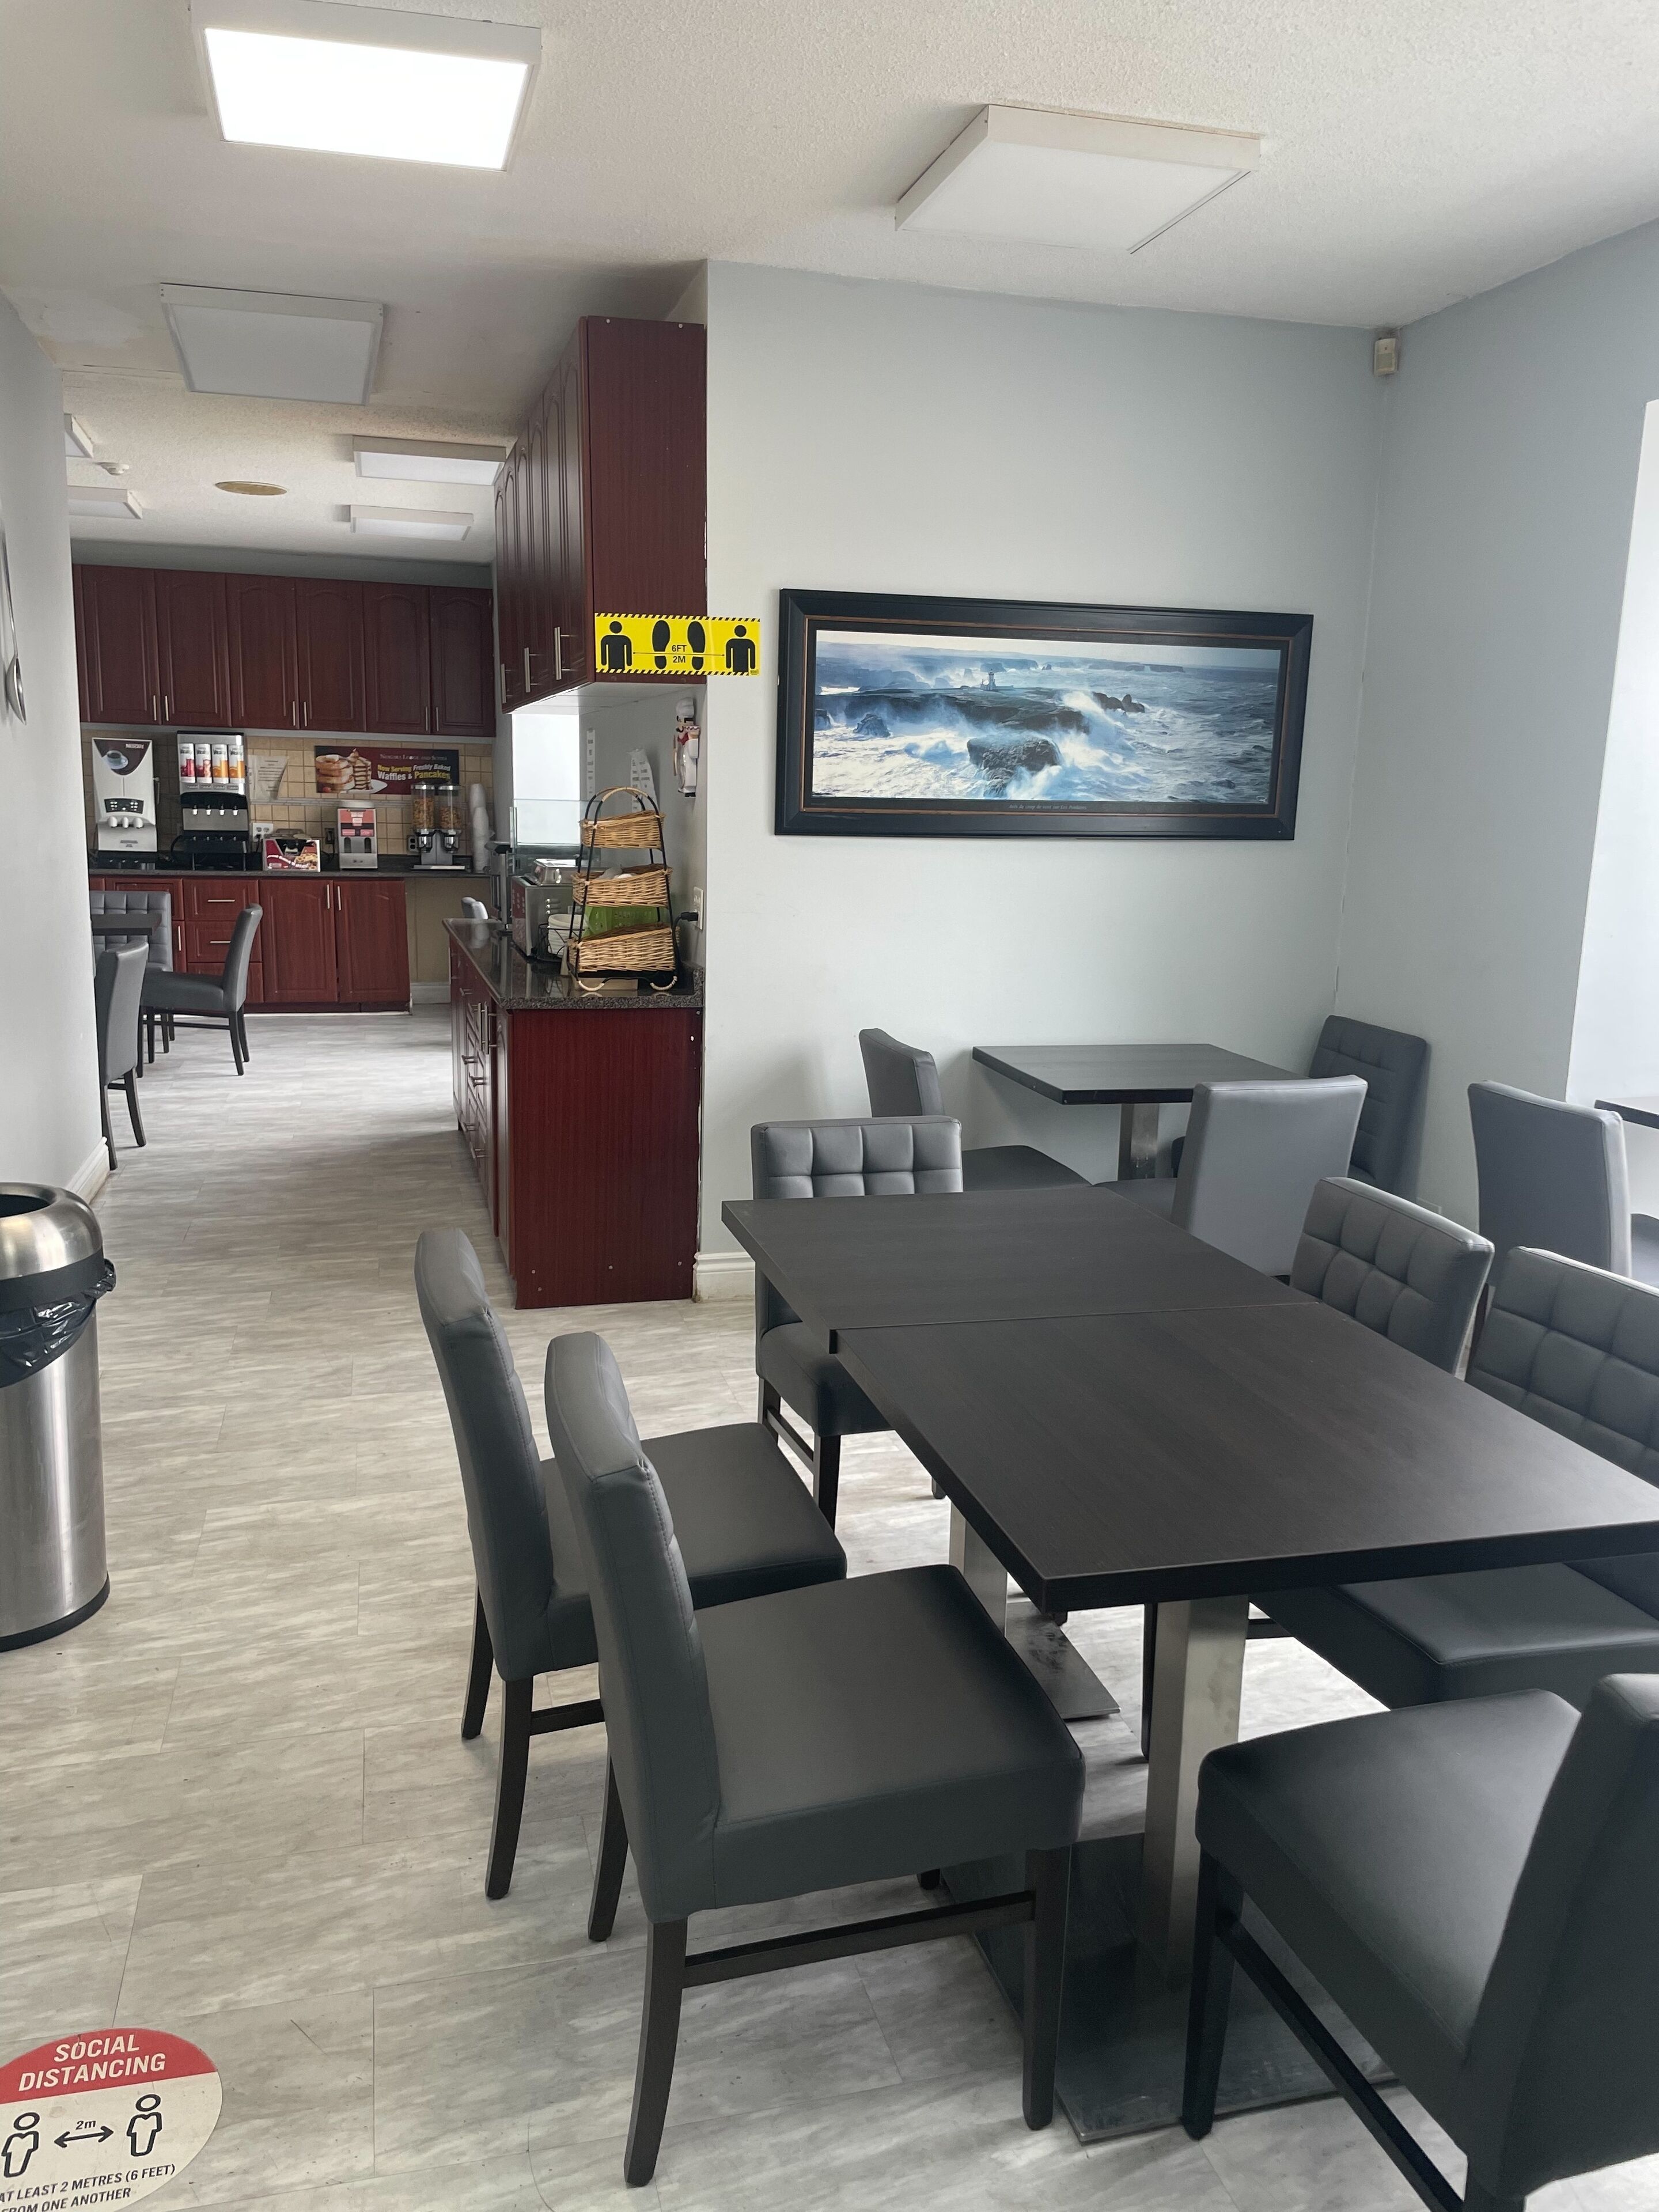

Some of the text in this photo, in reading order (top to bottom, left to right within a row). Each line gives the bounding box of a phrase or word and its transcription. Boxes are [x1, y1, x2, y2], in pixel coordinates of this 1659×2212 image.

[377, 771, 406, 781] Waffles
[54, 2034, 140, 2062] SOCIAL
[18, 2053, 166, 2092] DISTANCING
[75, 2120, 96, 2130] 2m
[17, 2183, 58, 2200] LEAST
[60, 2181, 69, 2192] 2
[71, 2172, 122, 2191] METRES
[126, 2170, 138, 2183] (6
[141, 2164, 175, 2179] FEET)
[41, 2198, 69, 2212] ONE
[70, 2187, 131, 2207] ANOTHER
